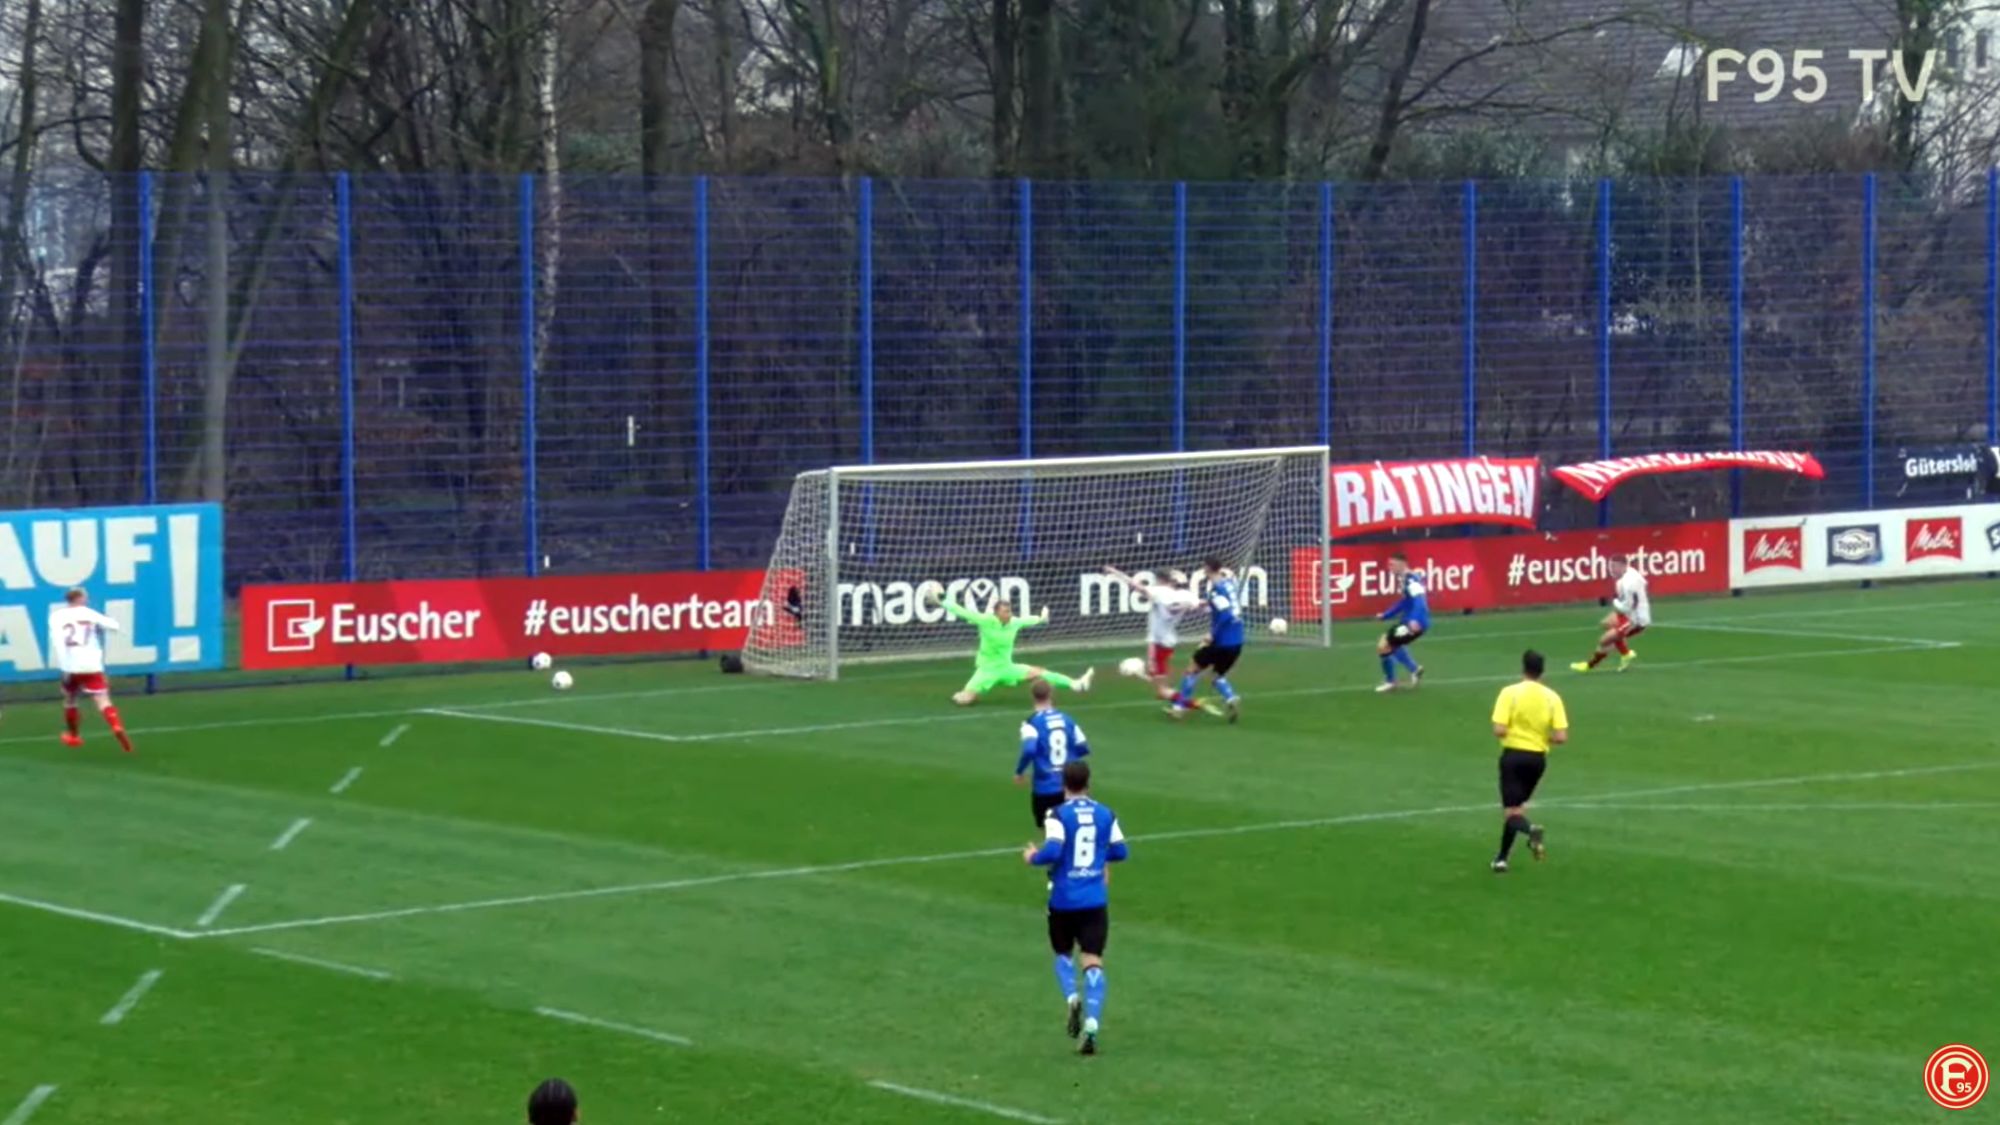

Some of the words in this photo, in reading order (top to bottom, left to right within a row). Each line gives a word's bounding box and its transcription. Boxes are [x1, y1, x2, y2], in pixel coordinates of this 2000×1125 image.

[1334, 461, 1536, 528] RATINGEN
[1360, 558, 1475, 597] Euher
[1508, 546, 1706, 587] #euschrteam
[0, 598, 157, 671] AL
[62, 620, 92, 648] 27
[331, 600, 481, 643] Euscher
[524, 592, 775, 636] #euscherteam
[1048, 728, 1067, 766] 8
[1073, 825, 1097, 868] 6
